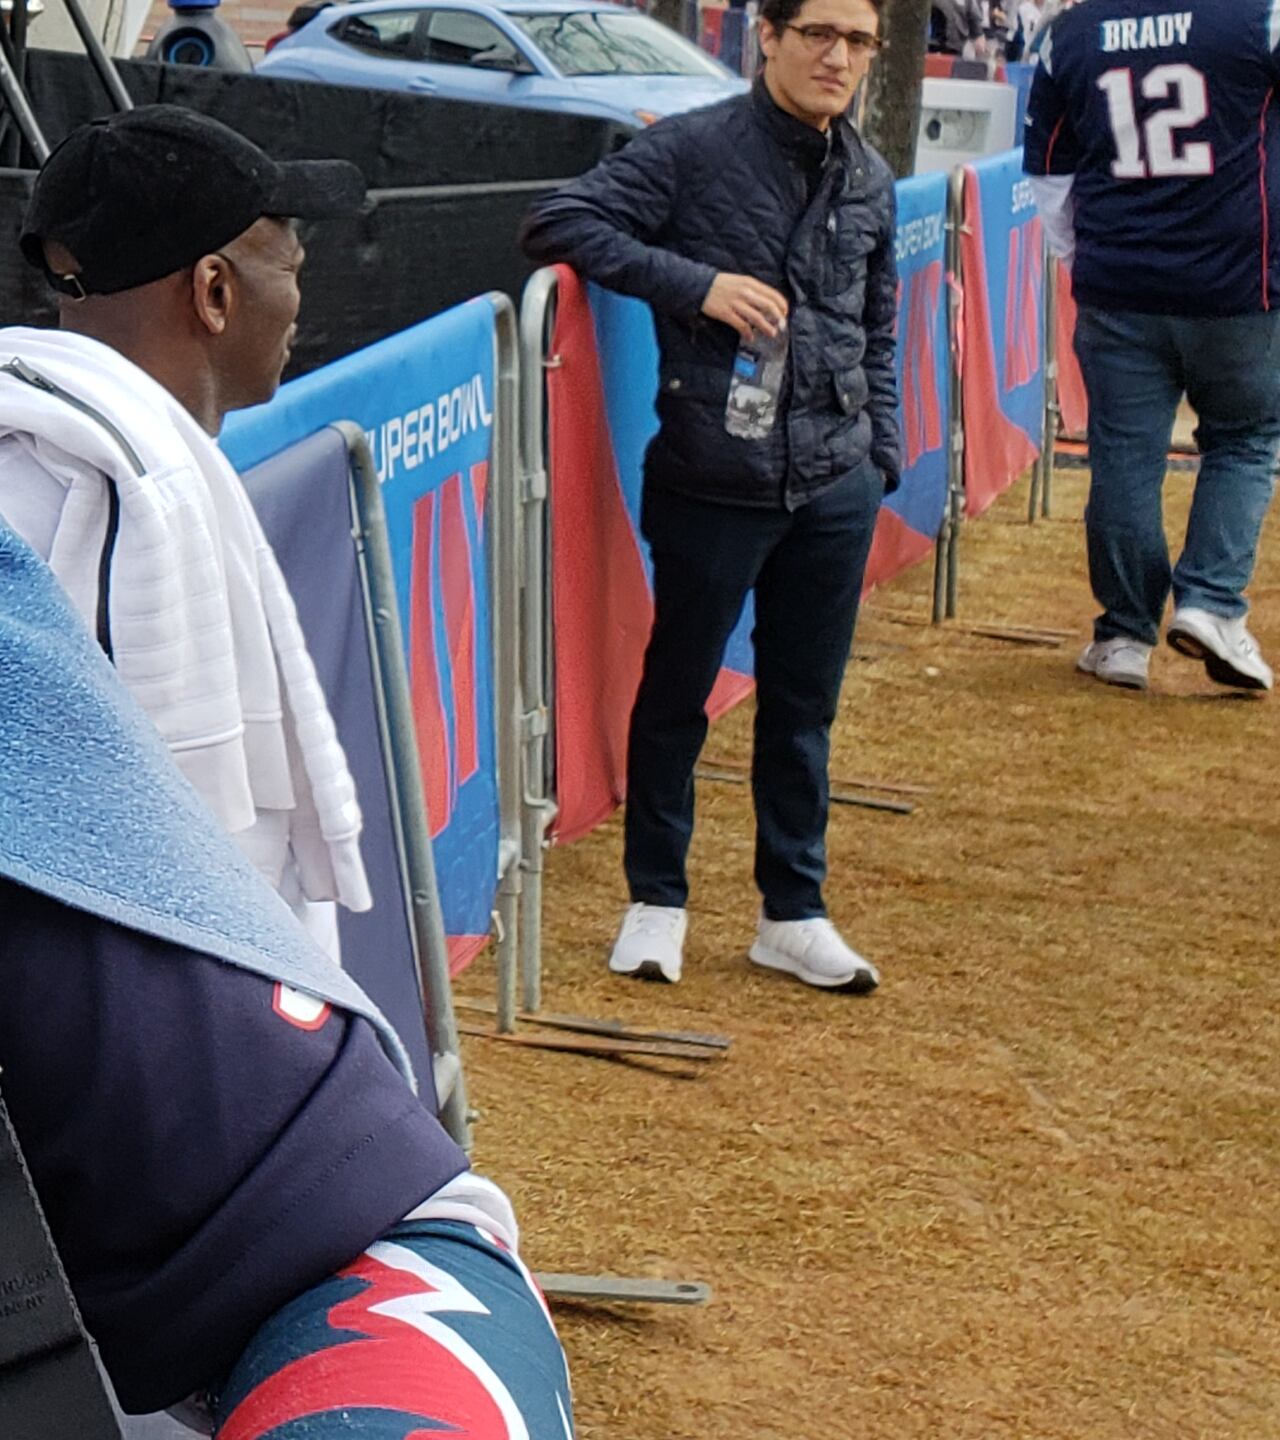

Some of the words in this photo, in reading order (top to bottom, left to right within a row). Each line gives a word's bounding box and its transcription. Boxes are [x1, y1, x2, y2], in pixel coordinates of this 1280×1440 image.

[1103, 12, 1192, 51] BRADY
[1096, 63, 1212, 179] 12
[364, 403, 434, 484] UPER
[438, 374, 492, 452] BOWL
